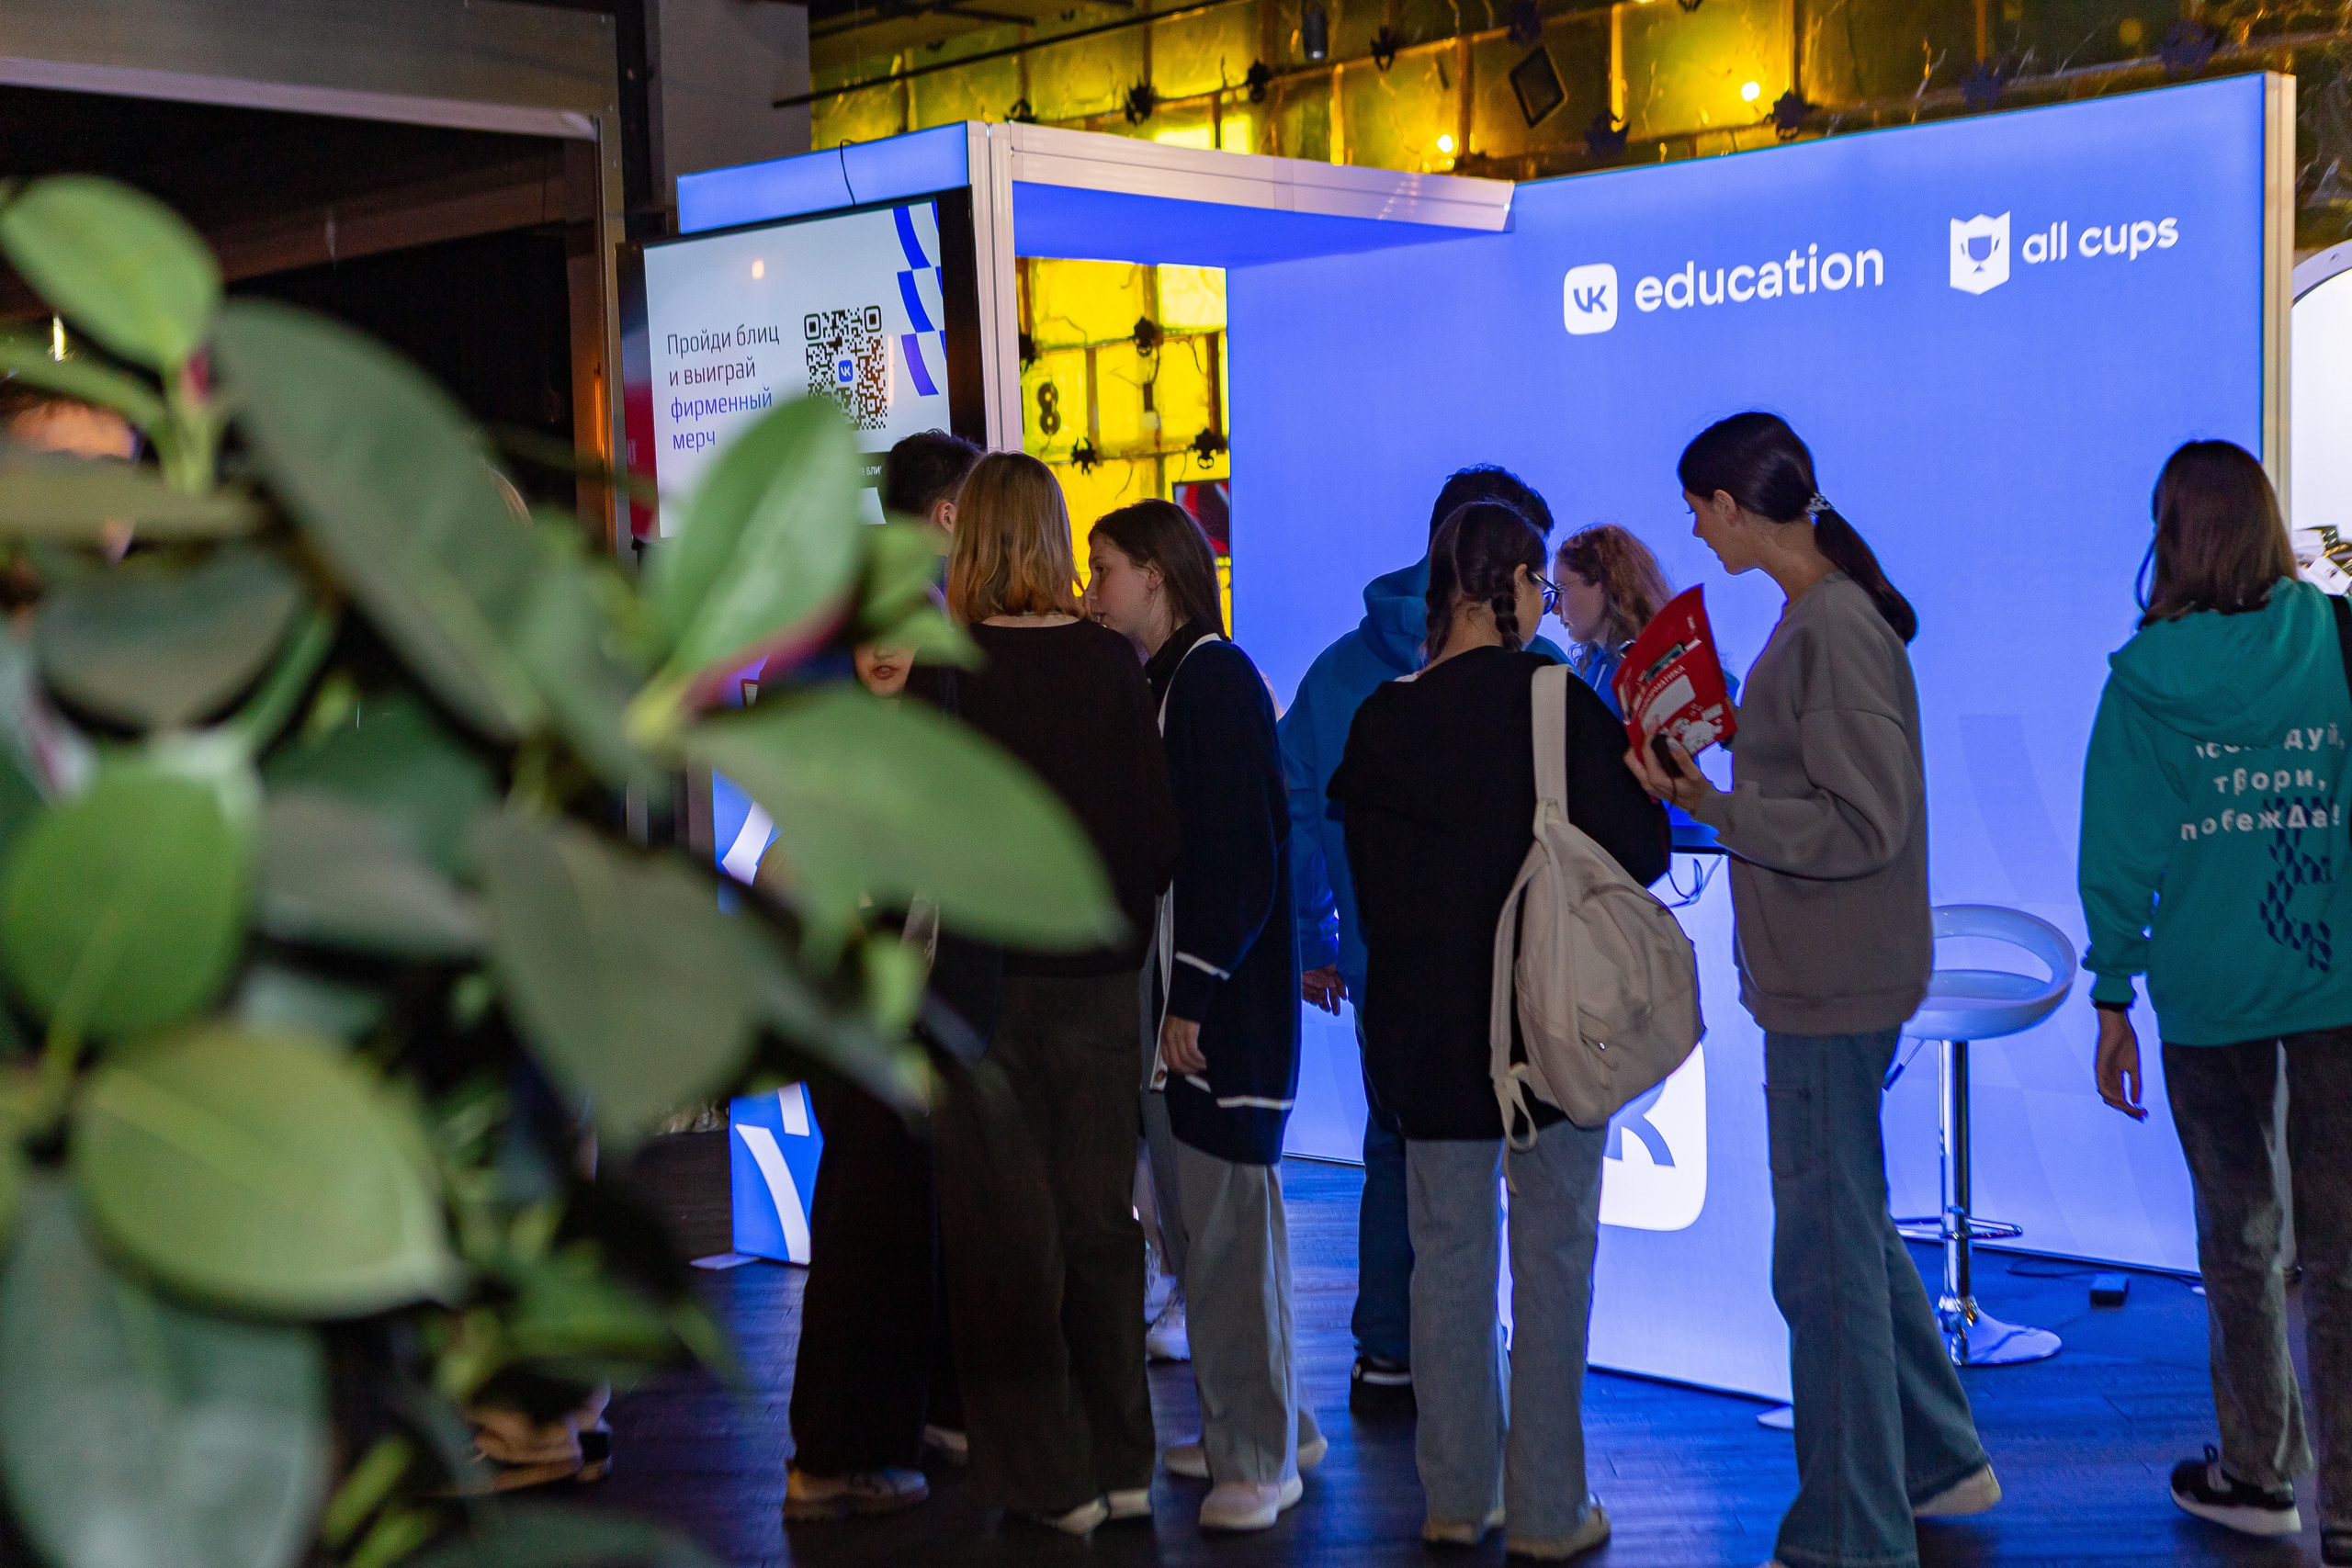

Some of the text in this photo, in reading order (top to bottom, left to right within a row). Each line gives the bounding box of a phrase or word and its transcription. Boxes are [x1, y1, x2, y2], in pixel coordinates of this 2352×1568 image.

[2022, 217, 2179, 265] all cups
[1634, 242, 1883, 313] education
[667, 323, 780, 359] Пройди блиц
[669, 355, 756, 388] и выиграй
[671, 386, 773, 423] фирменный
[673, 430, 716, 453] мерч
[865, 465, 882, 476] БЛИ
[2212, 767, 2326, 796] твори,
